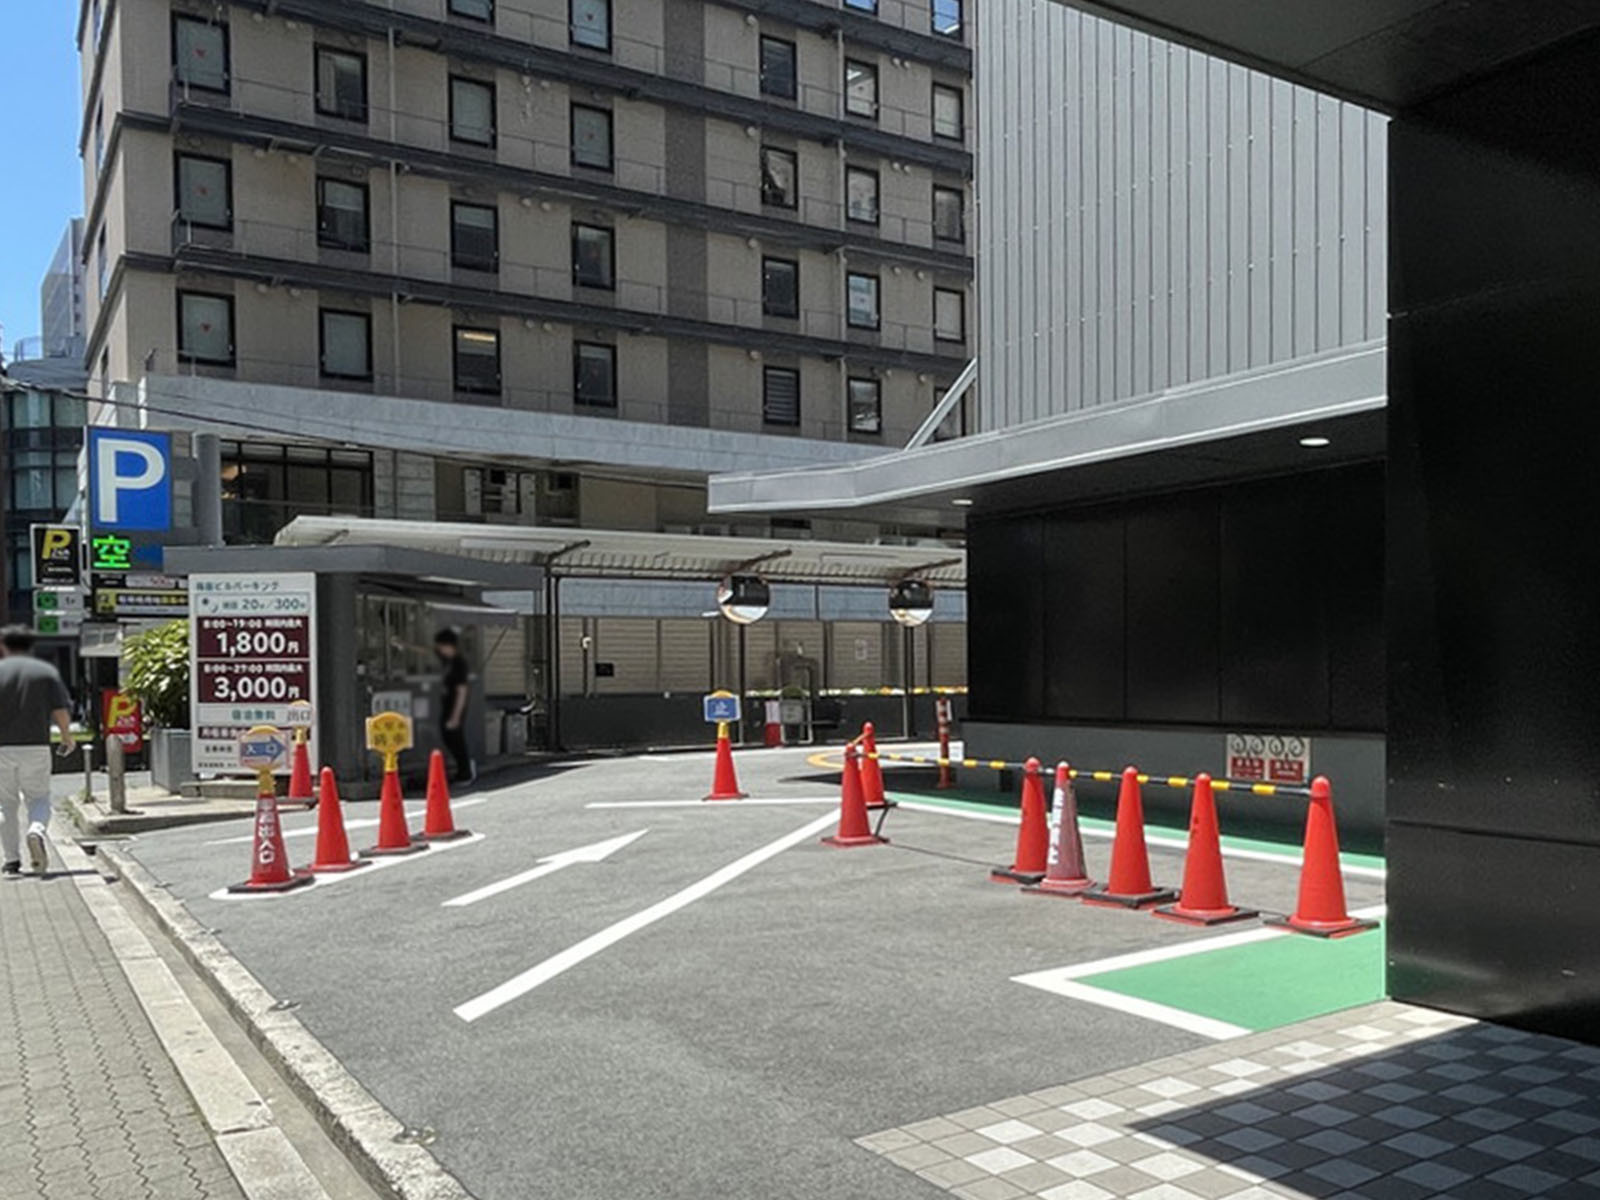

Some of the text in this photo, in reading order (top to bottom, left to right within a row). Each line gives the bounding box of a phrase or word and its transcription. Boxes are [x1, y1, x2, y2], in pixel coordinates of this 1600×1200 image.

[97, 438, 166, 524] P
[41, 530, 72, 560] P
[92, 535, 132, 569] 空
[246, 744, 278, 755] 入口
